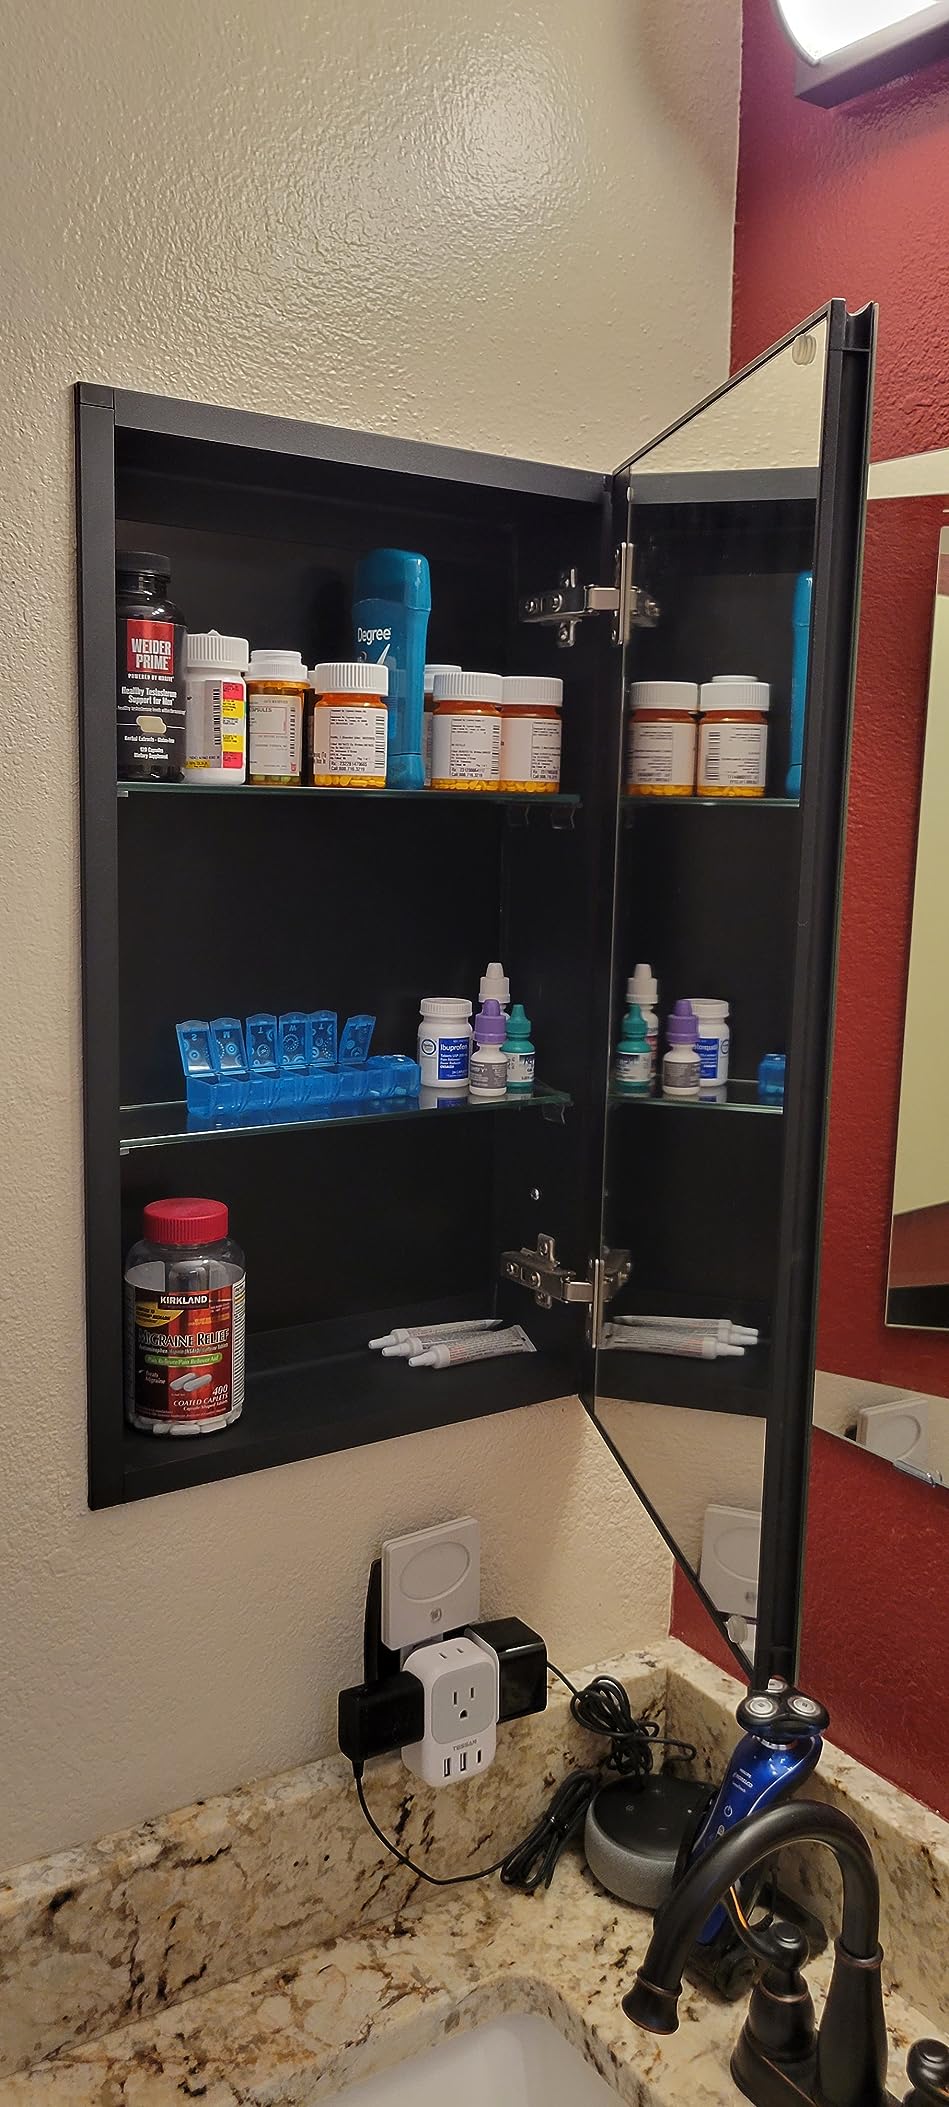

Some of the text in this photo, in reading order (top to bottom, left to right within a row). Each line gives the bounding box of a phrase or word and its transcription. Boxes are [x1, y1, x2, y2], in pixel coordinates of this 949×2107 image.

[357, 627, 391, 646] Degree
[131, 637, 172, 656] WEIDER
[135, 653, 170, 671] PRIME
[121, 686, 178, 699] Healthy Testosterone
[128, 694, 152, 706] Support
[440, 1043, 468, 1053] Ibuprofen
[160, 1295, 208, 1305] KIRKLAND
[137, 1328, 230, 1348] MIGRAINE RELIEF
[212, 1384, 229, 1396] 400
[173, 1399, 202, 1407] COATED
